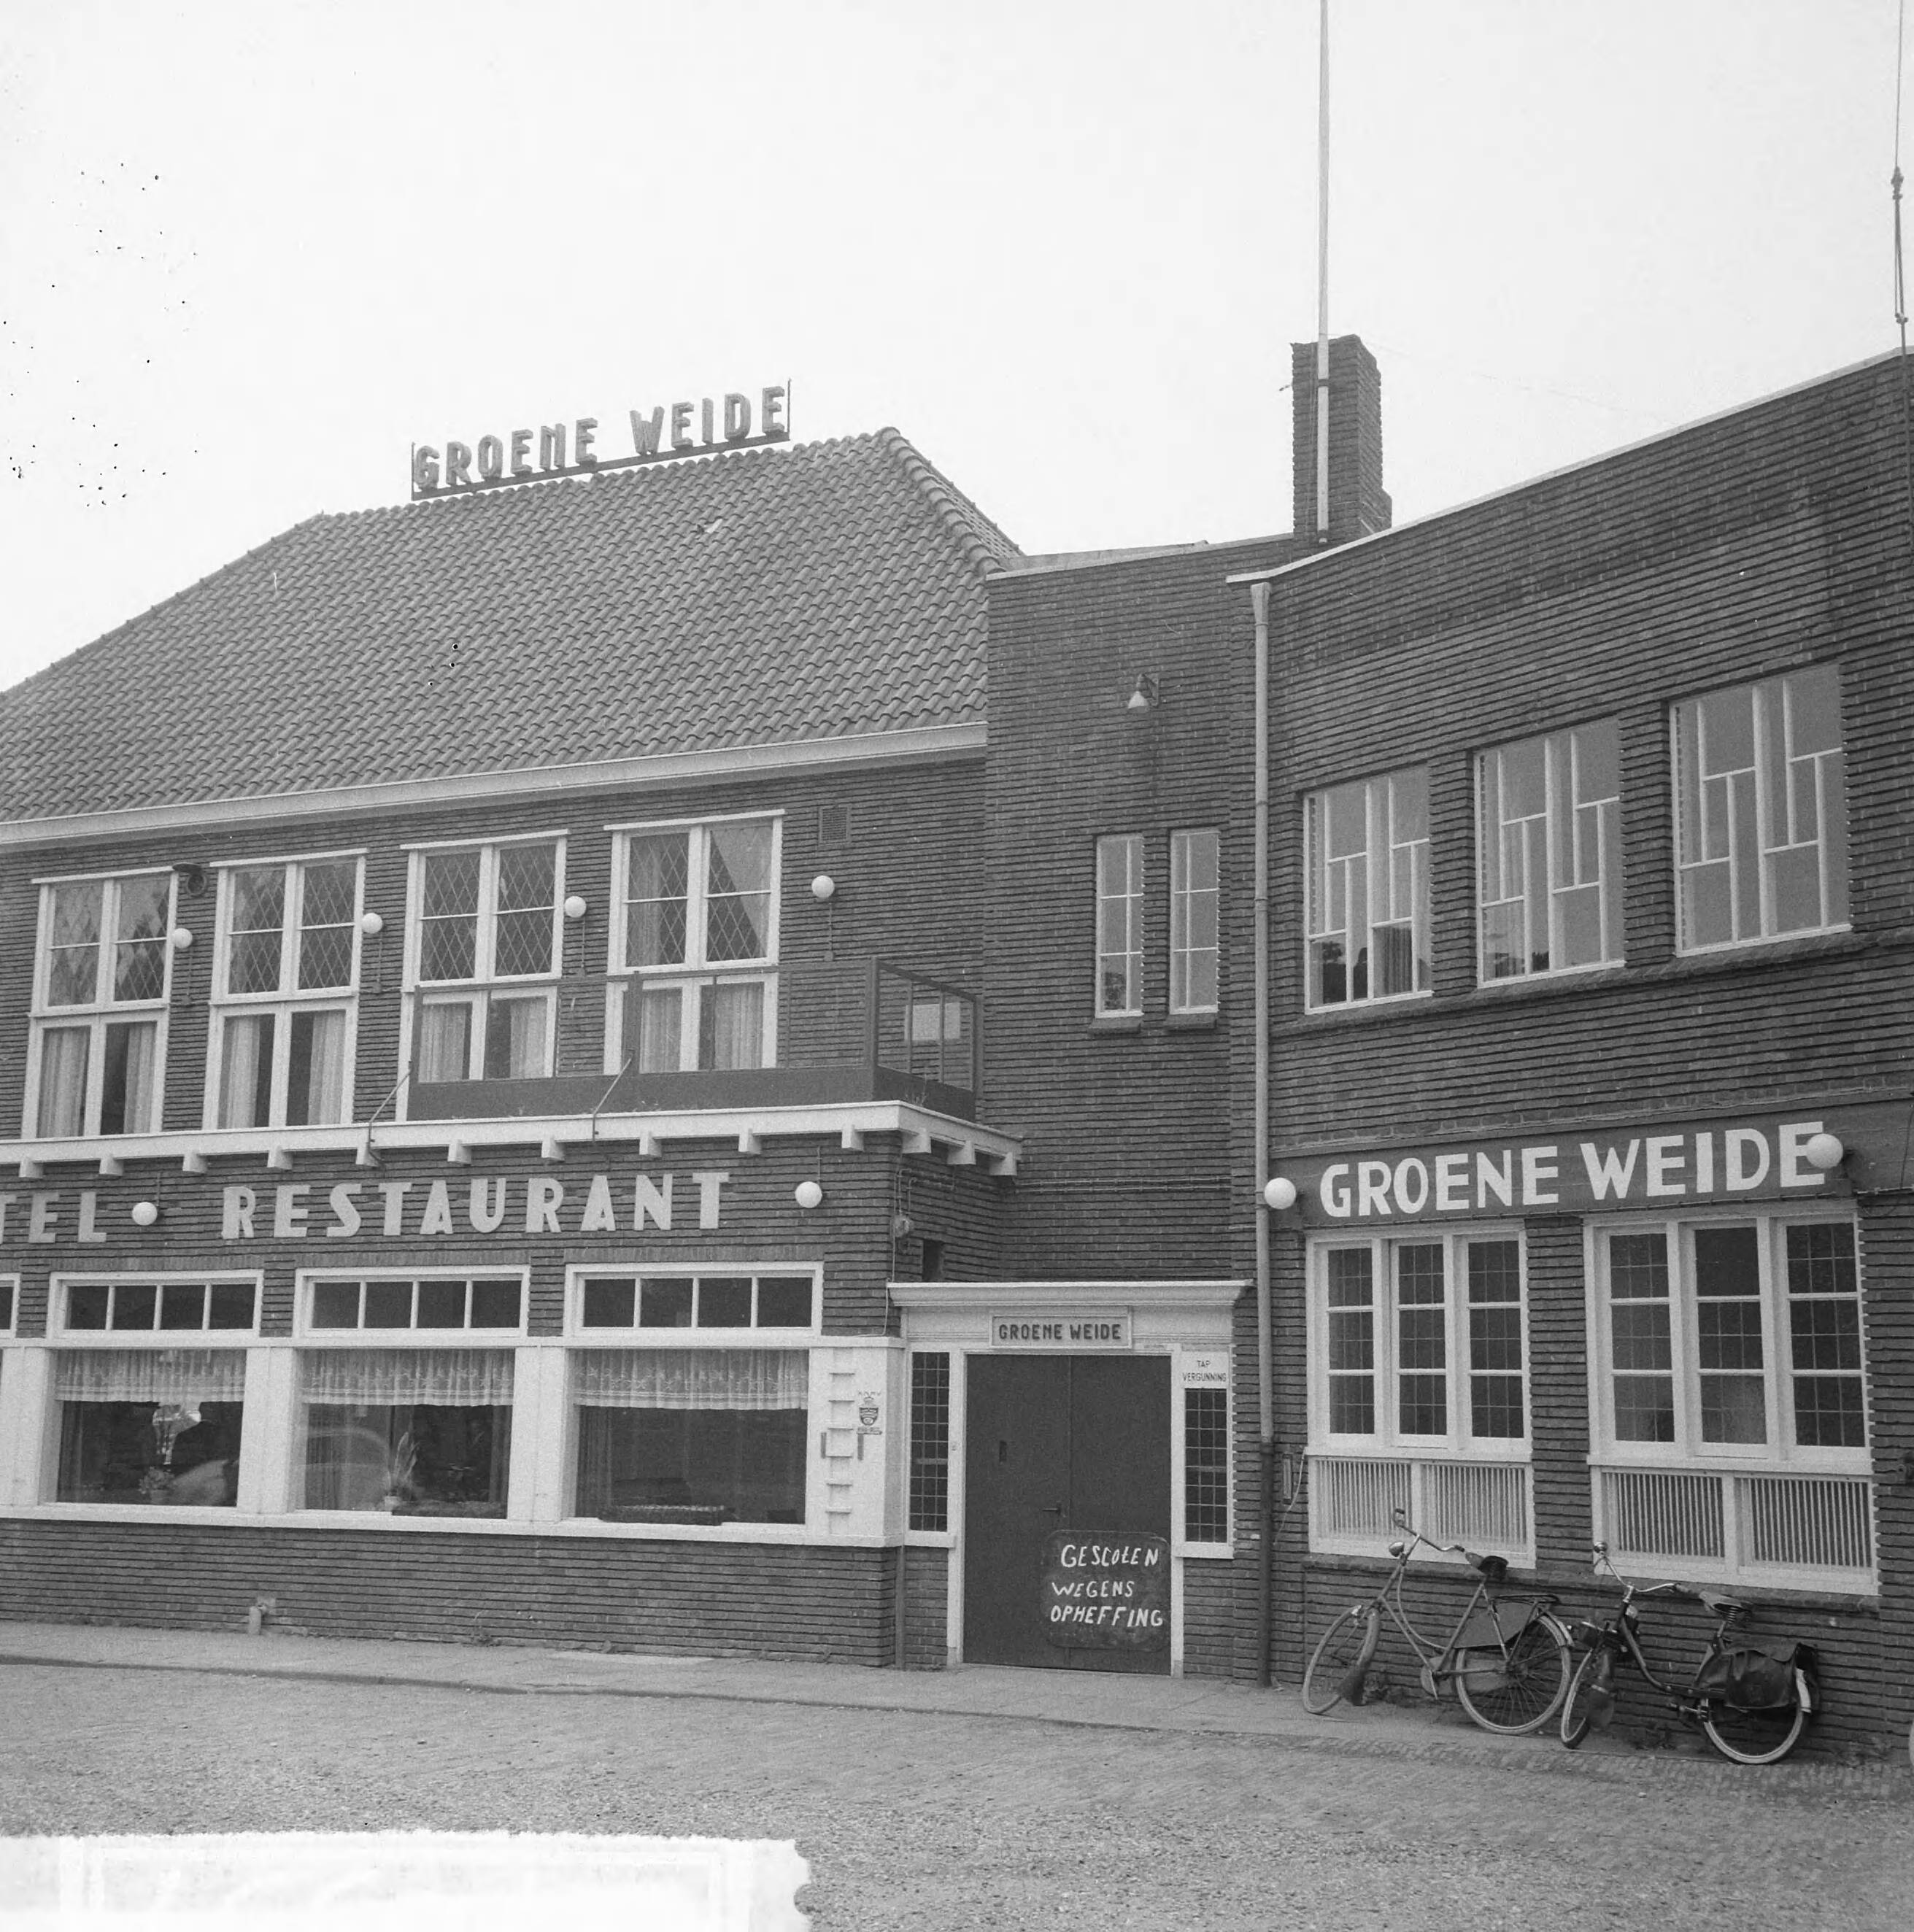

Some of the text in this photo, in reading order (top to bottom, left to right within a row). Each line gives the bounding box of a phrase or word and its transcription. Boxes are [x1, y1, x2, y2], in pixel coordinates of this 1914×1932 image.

[414, 386, 785, 490] GROENE WEIDE
[1320, 1121, 1825, 1218] GROENE WEIDE
[221, 1172, 730, 1240] RESTAURANT
[998, 1324, 1122, 1340] GROENE WEIDE
[1197, 1360, 1211, 1368] TAP
[1182, 1372, 1227, 1382] VERGUNNING
[1051, 1580, 1135, 1598] WEGENS
[1051, 1605, 1163, 1628] OPHEFFING
